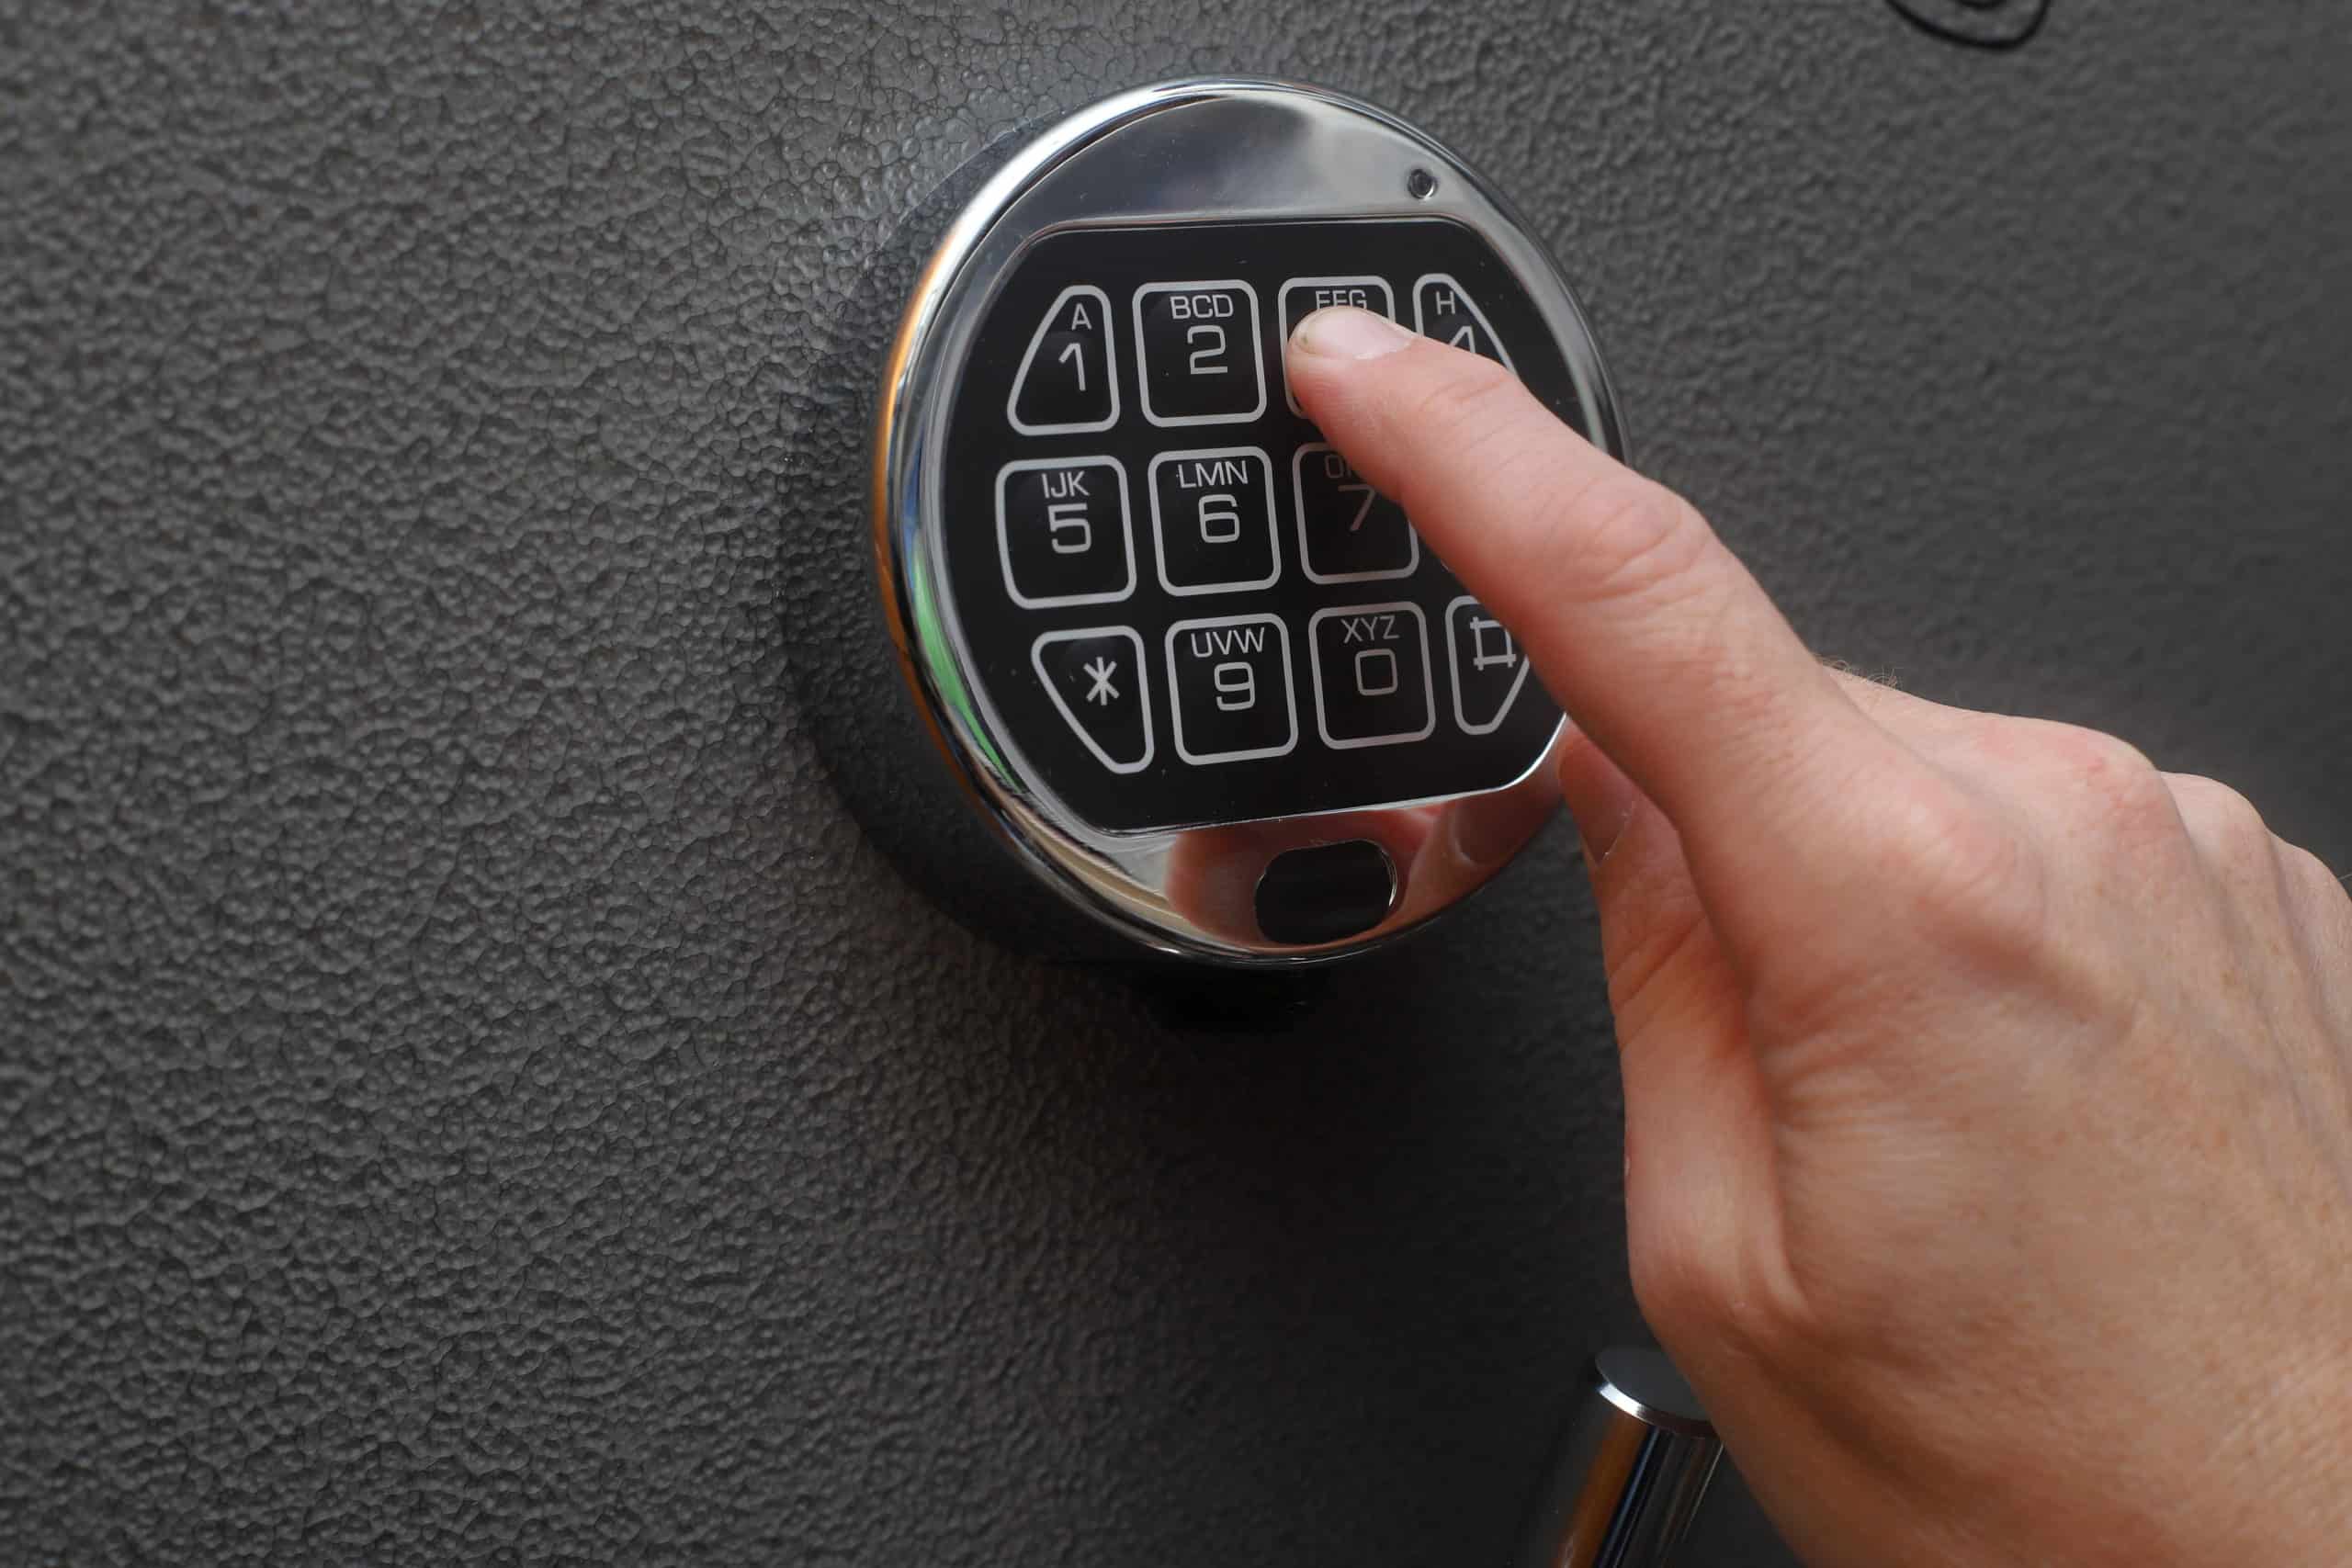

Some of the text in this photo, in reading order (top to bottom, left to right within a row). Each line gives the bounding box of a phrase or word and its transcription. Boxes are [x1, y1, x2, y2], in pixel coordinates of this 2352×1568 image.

[1072, 303, 1093, 332] A
[1170, 294, 1235, 321] BCD
[1436, 288, 1458, 316] H
[1187, 325, 1229, 376] 2
[1059, 343, 1087, 392] 1
[1042, 471, 1091, 500] IJK
[1180, 458, 1250, 490] LMN
[1199, 494, 1241, 545] 6
[1337, 483, 1376, 532] 7
[1048, 503, 1092, 555] 5
[1188, 626, 1266, 659] UVW
[1339, 614, 1399, 644] XYZ
[1215, 662, 1257, 712] 9
